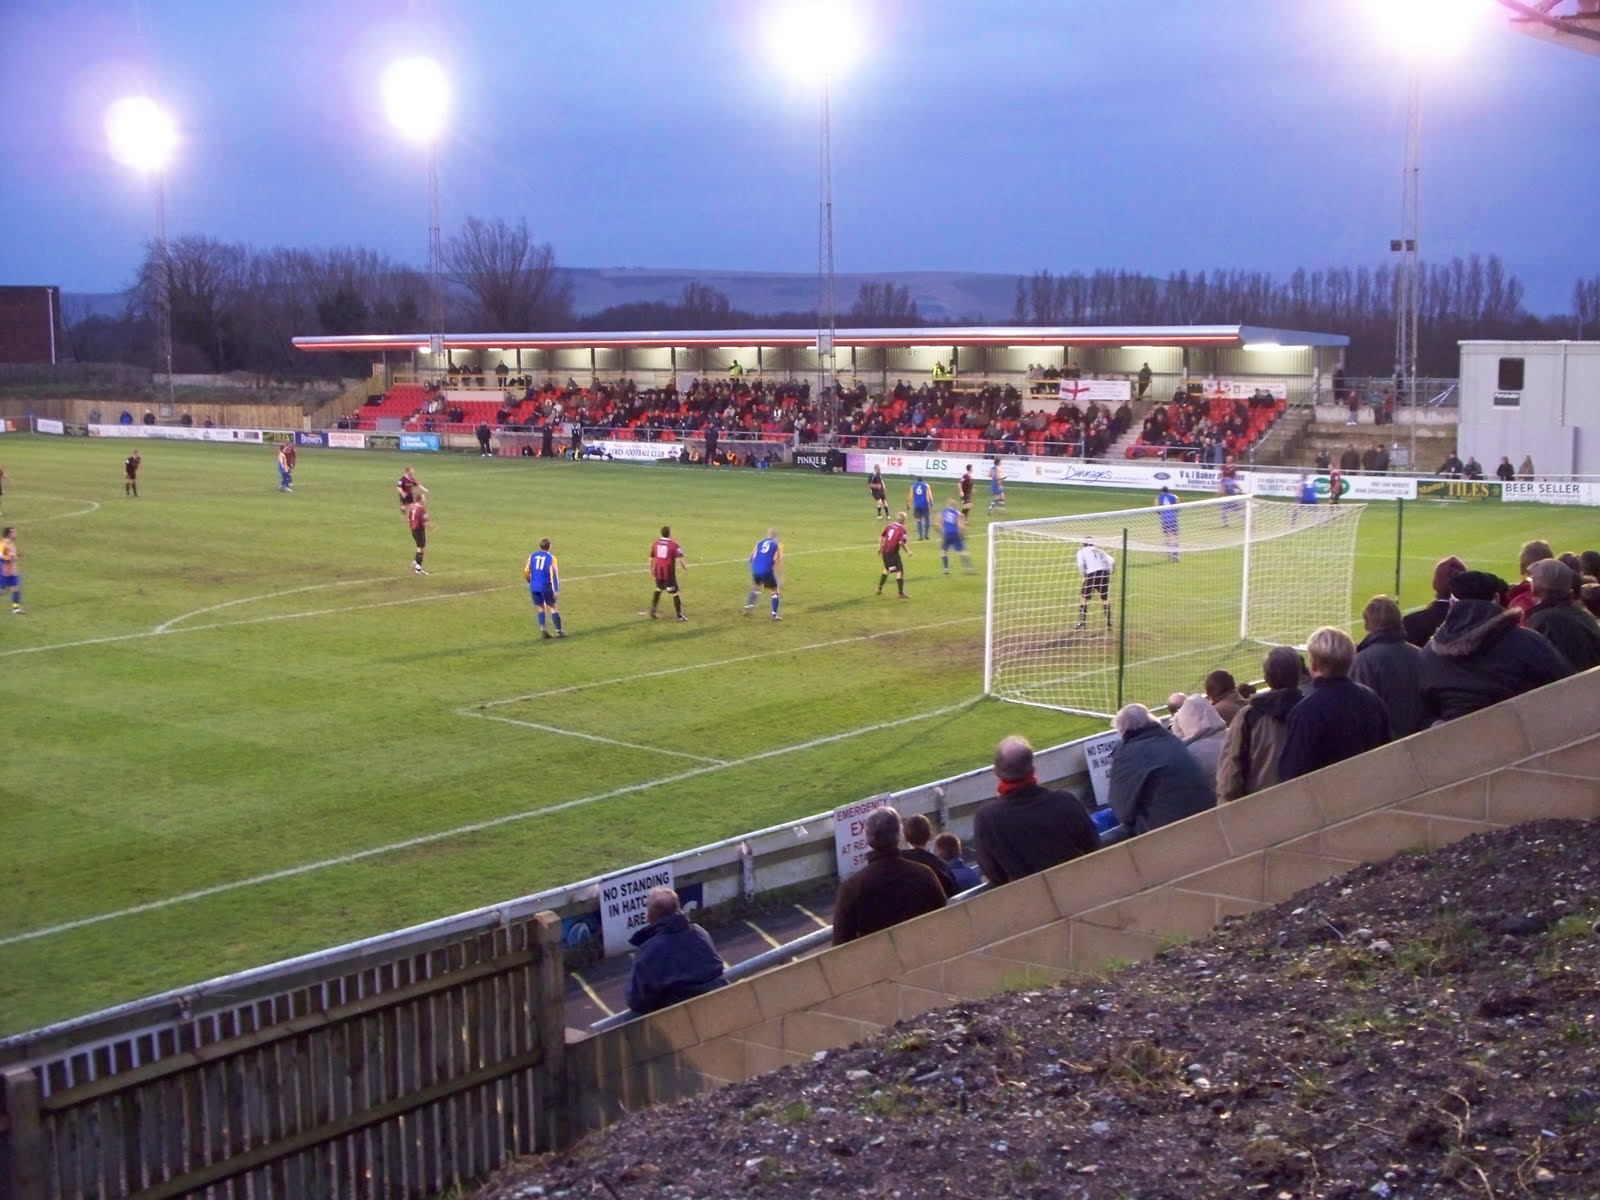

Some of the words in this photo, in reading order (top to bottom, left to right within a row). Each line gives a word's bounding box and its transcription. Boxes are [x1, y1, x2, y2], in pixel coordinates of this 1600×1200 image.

[625, 448, 650, 457] FOOTBALL
[887, 457, 903, 466] ICS
[925, 459, 948, 470] LBS
[1195, 471, 1216, 479] Baker
[916, 485, 923, 495] 6
[1447, 482, 1489, 498] TILES
[1505, 483, 1534, 492] BEER
[1538, 484, 1580, 493] SELLER
[888, 529, 895, 541] 9
[534, 555, 546, 571] 11
[1087, 746, 1096, 756] NO
[836, 798, 888, 822] EMERGENCY
[851, 820, 865, 837] EX
[842, 843, 851, 856] AT
[603, 886, 618, 902] NO
[620, 871, 670, 897] STANDING
[608, 902, 620, 918] IN
[627, 912, 646, 929] ARE
